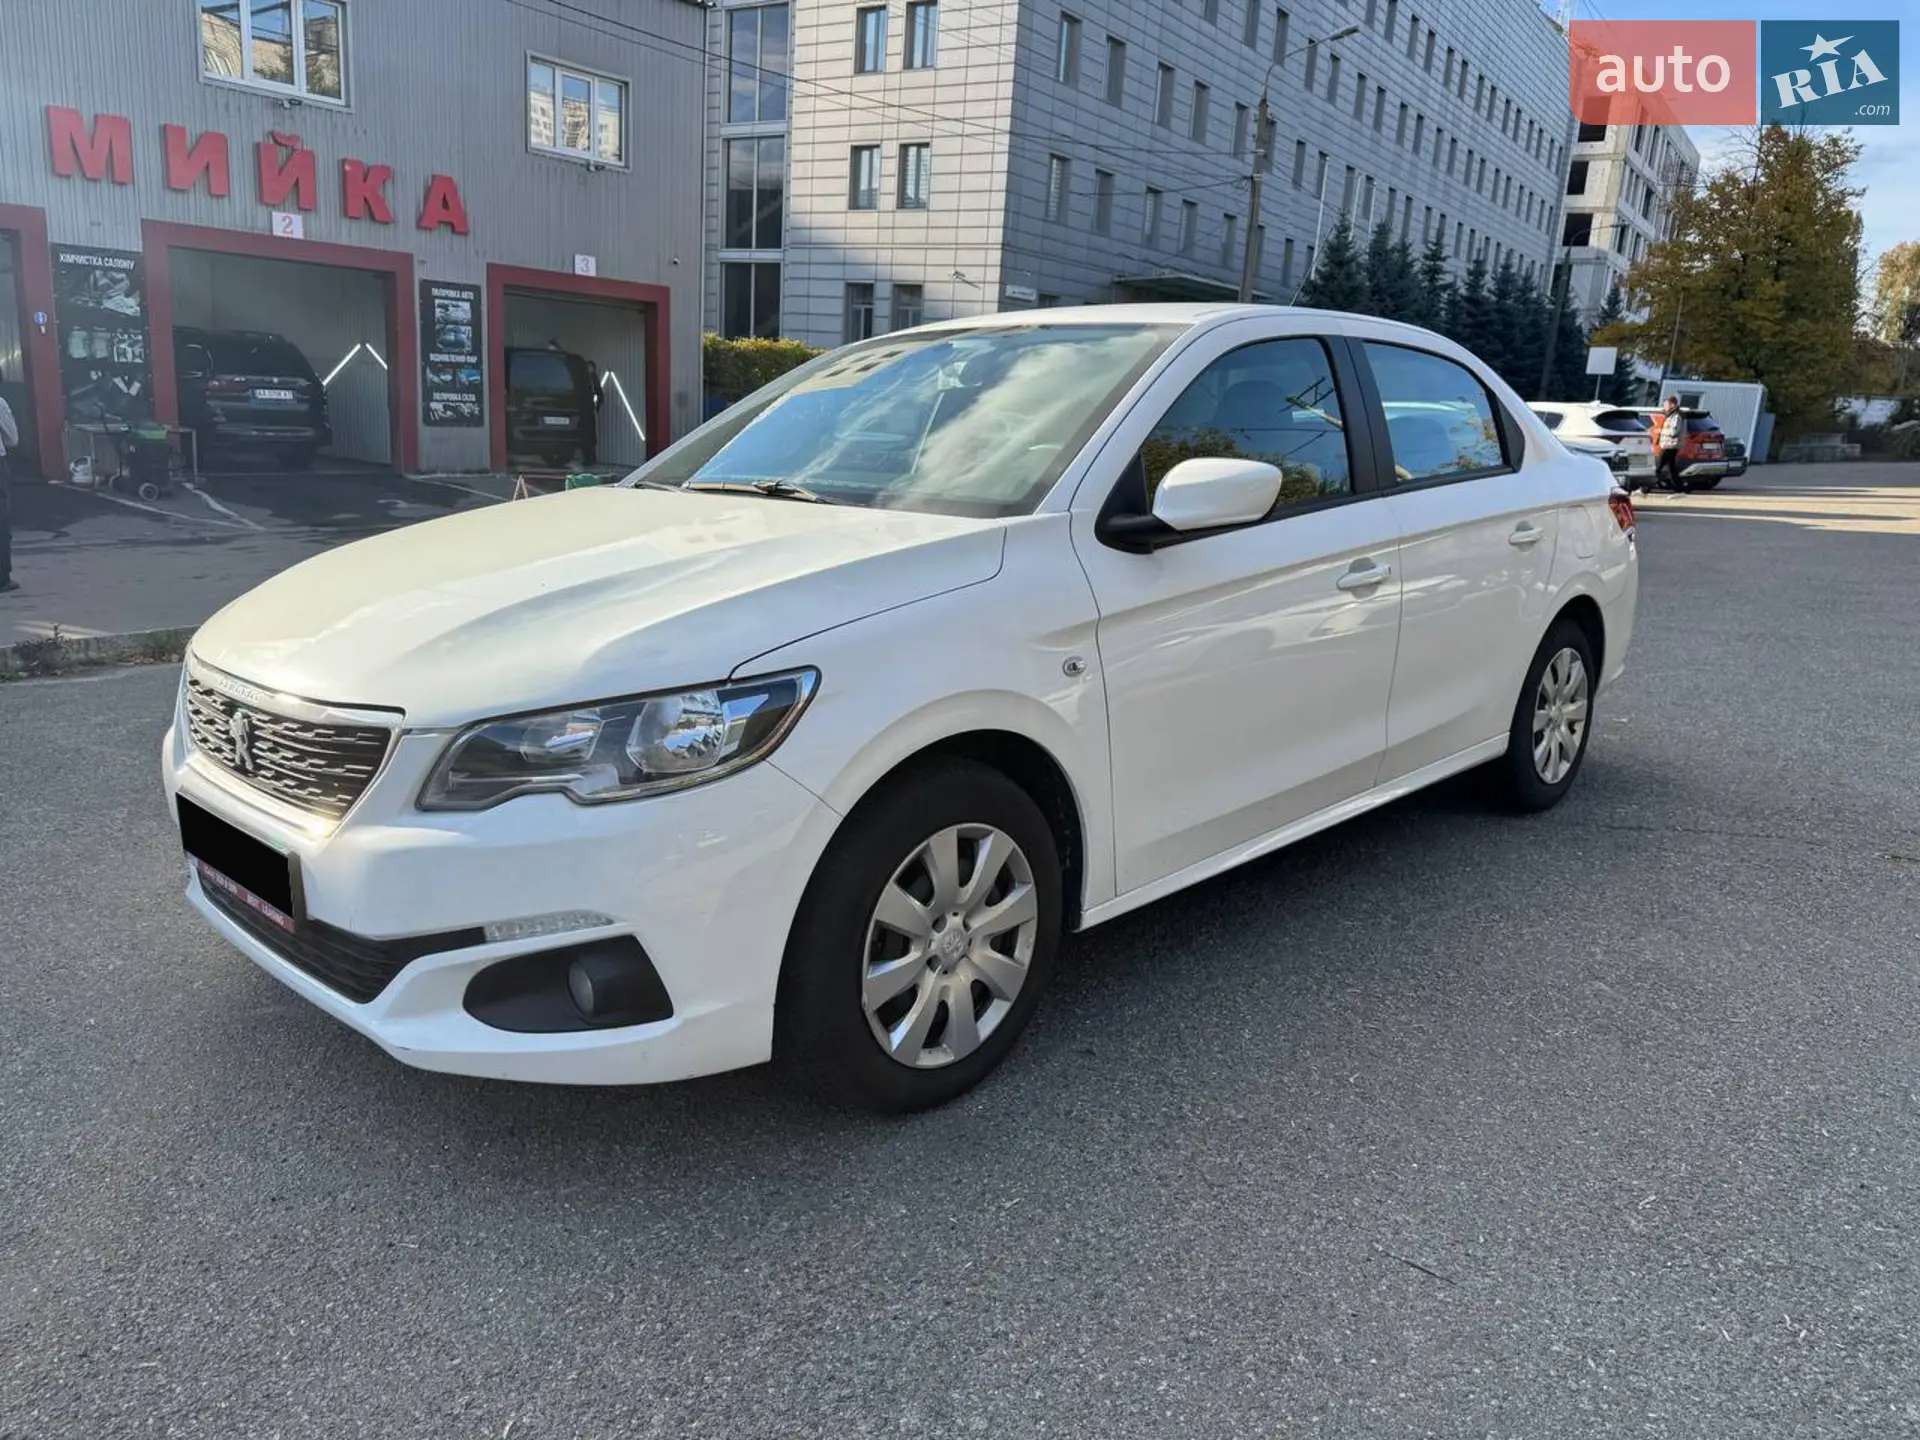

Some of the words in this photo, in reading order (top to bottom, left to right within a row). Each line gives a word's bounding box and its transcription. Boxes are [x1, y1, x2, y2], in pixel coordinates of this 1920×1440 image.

[46, 105, 470, 236] МИЙКА
[282, 214, 294, 235] 2
[580, 257, 590, 273] 3
